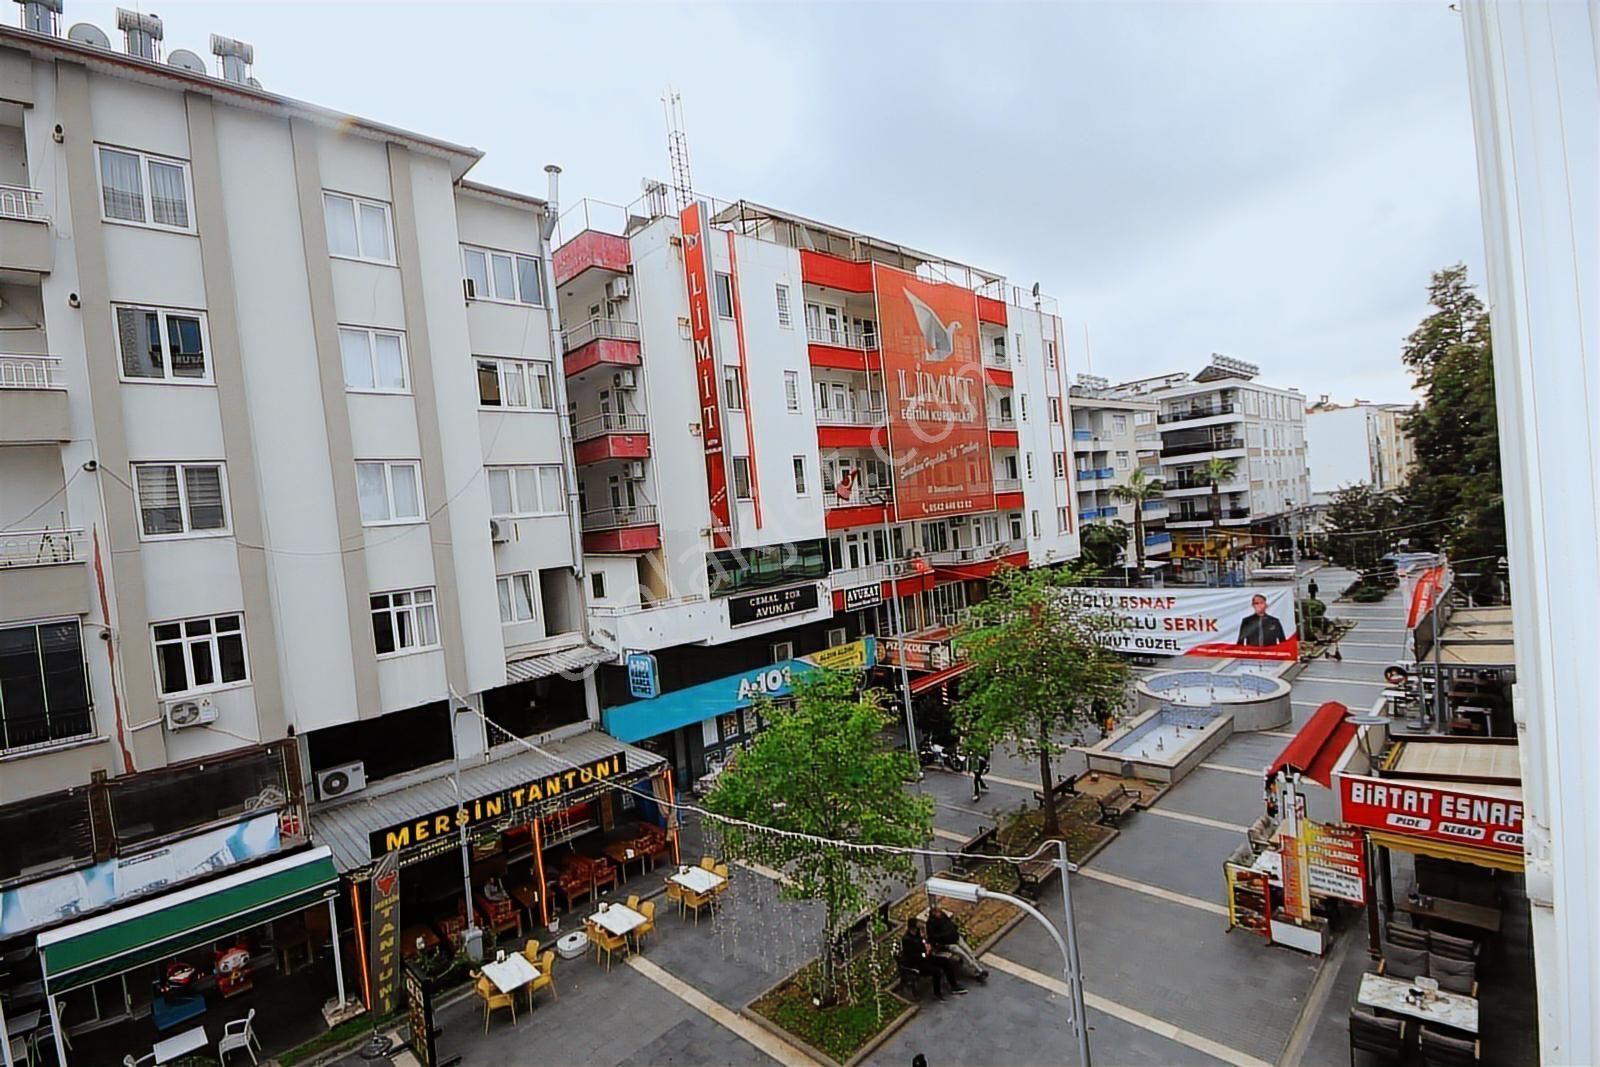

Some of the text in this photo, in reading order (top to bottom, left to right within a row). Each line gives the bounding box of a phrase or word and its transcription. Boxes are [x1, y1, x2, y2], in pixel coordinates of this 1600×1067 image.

[897, 363, 975, 405] LİMİT
[847, 585, 879, 602] AVUKAT
[755, 601, 796, 618] AVUKAT
[1119, 596, 1175, 610] ESNAF
[1164, 614, 1219, 632] SERİK
[1135, 635, 1181, 651] GÜZEL
[1441, 795, 1523, 828] ESNAF
[385, 800, 502, 852] MERSİN
[1443, 825, 1481, 837] KEBAP
